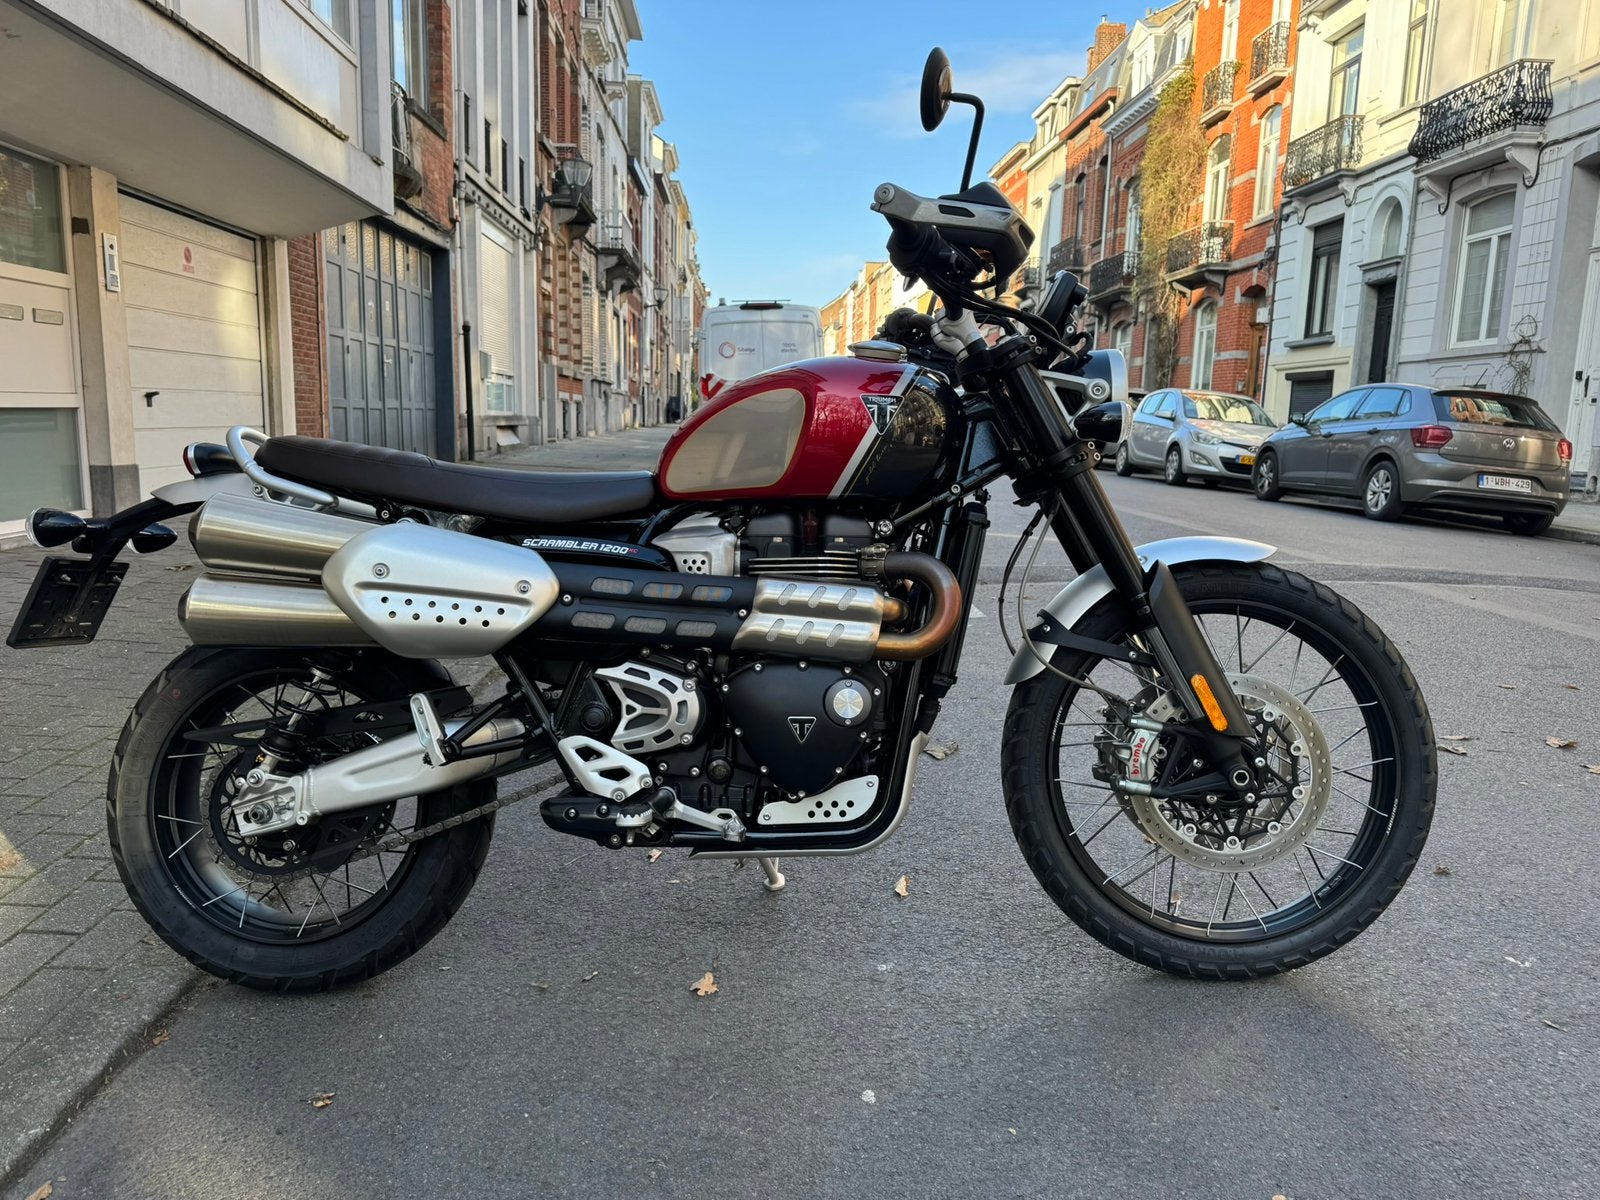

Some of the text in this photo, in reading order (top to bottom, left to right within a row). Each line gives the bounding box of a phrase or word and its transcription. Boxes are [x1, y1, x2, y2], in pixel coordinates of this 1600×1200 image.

[522, 538, 599, 550] SCRAMBLER
[599, 543, 629, 554] 1200
[1131, 737, 1146, 776] brembo
